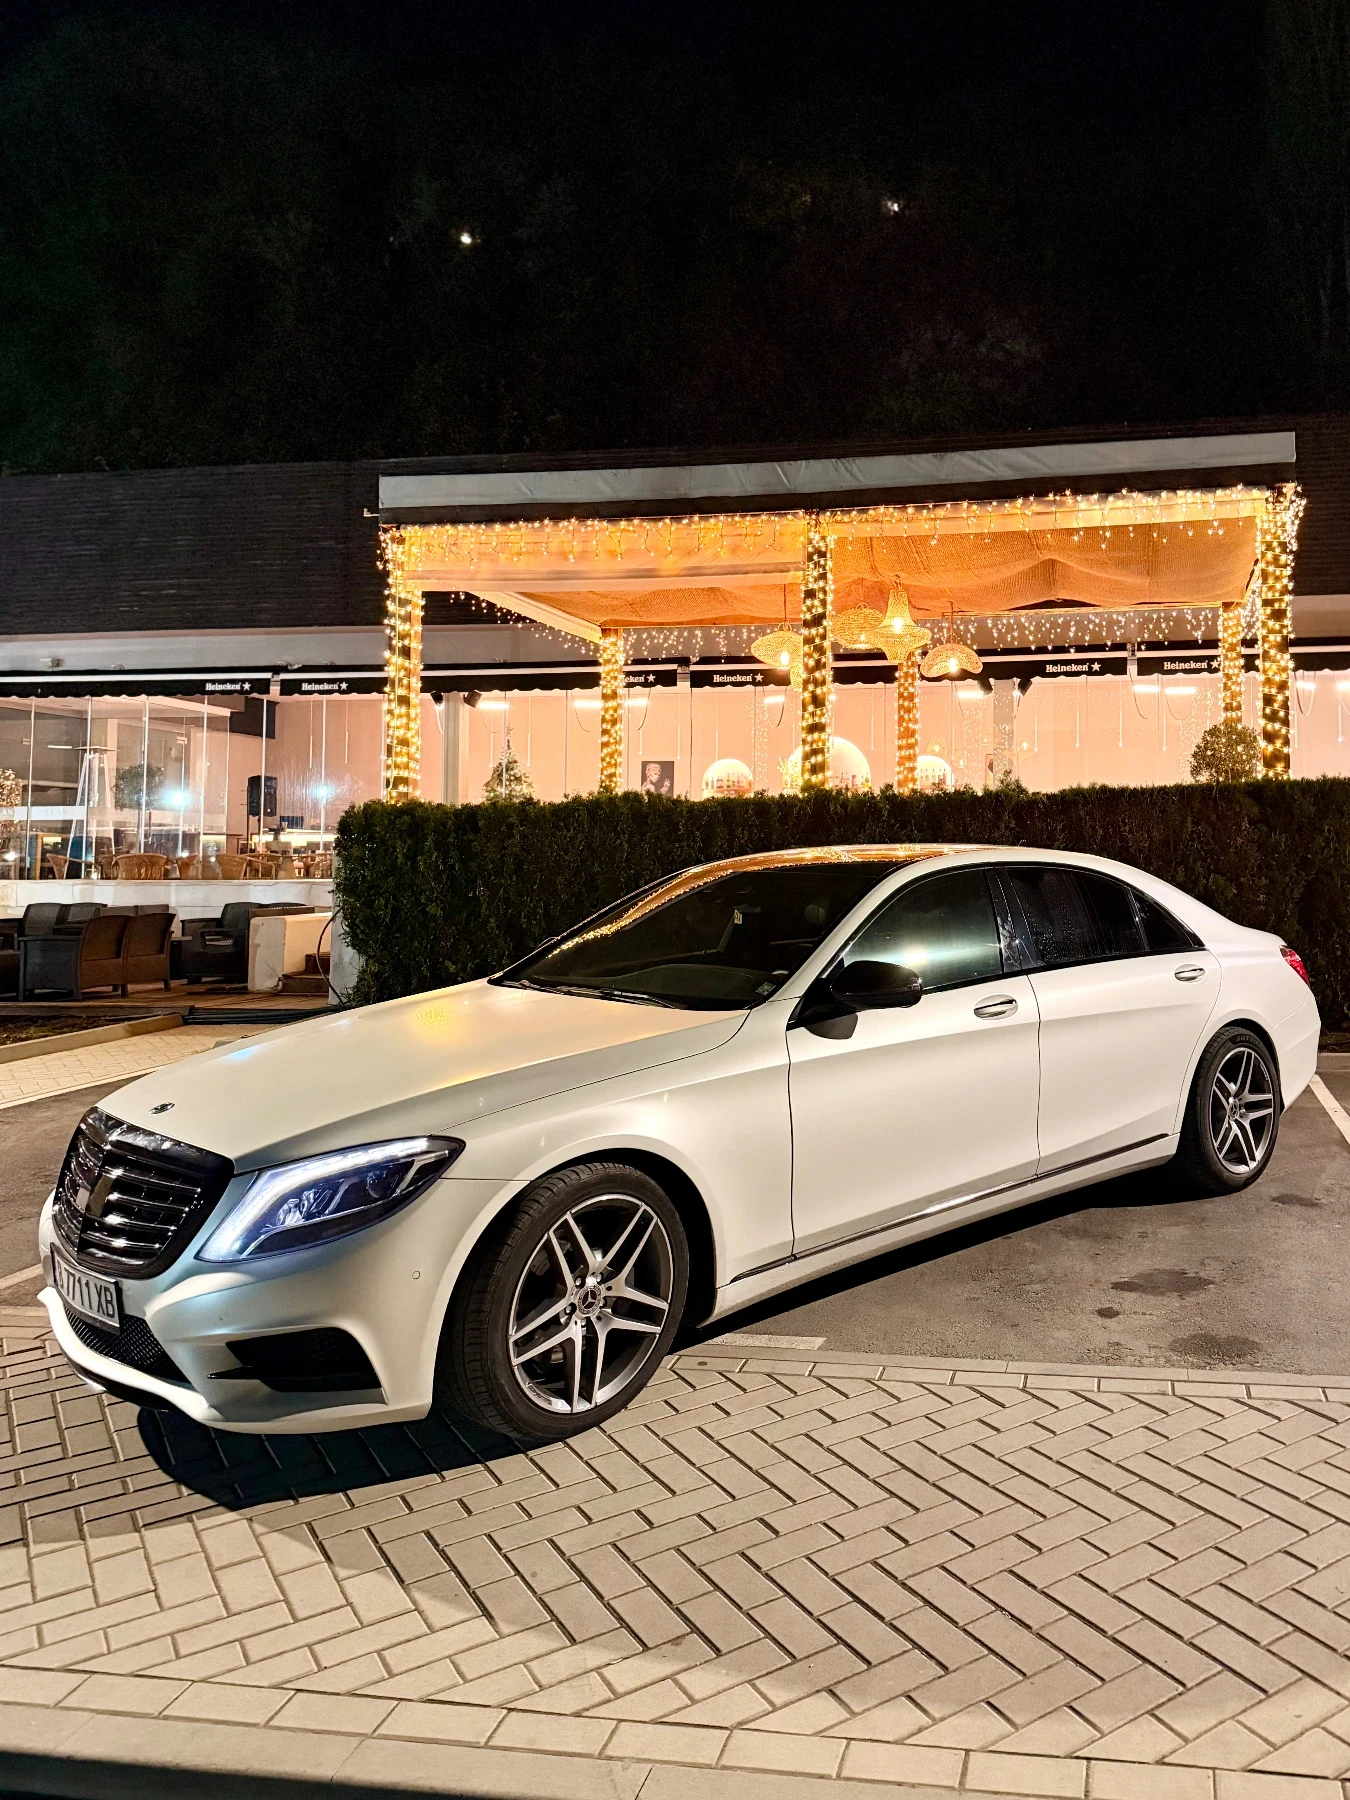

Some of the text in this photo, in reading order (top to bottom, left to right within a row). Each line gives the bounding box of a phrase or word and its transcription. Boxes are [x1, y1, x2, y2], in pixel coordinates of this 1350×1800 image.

[1046, 663, 1090, 673] Heineken
[1164, 660, 1209, 670] Heineken
[624, 674, 645, 683] eken
[713, 674, 753, 683] Heineken
[205, 682, 242, 691] Heineken
[301, 682, 339, 691] Heineken
